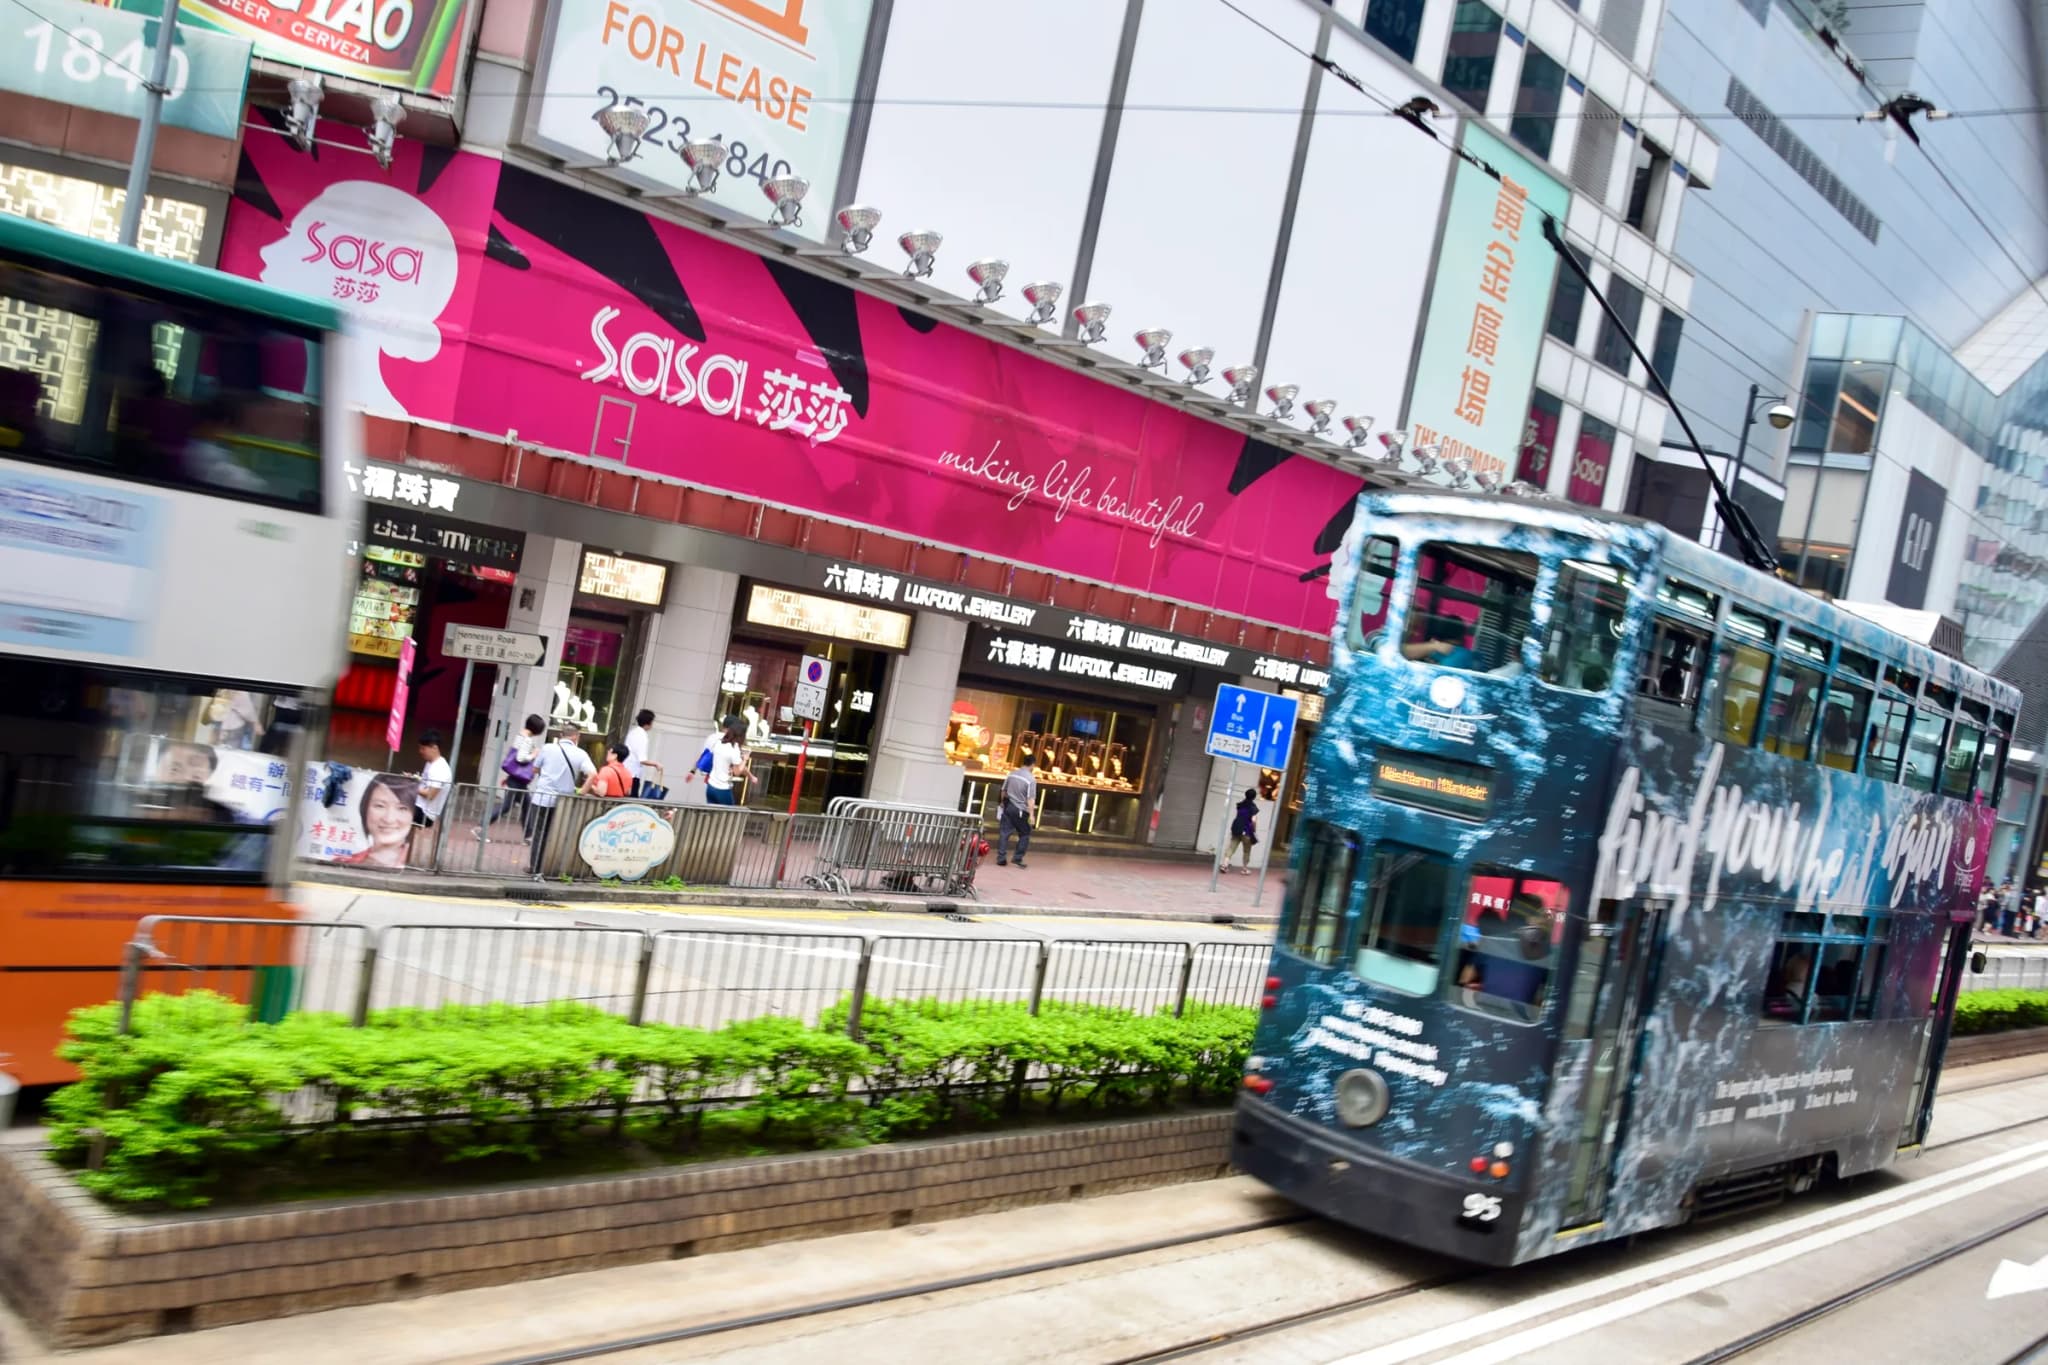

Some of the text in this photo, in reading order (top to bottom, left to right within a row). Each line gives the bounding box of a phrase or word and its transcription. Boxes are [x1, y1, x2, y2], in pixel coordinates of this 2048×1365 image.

[291, 21, 370, 63] CERVEZA
[602, 1, 812, 132] FOR LEASE
[333, 275, 380, 303] 莎莎
[757, 369, 852, 442] 莎莎
[938, 440, 1204, 549] making life beautiful
[1901, 513, 1933, 571] GAP
[824, 564, 1036, 627] 六福珠寶 LUKFOOK JEWELLERY
[458, 631, 517, 645] Hennessy Road
[1066, 616, 1230, 666] 六福珠寶 LUKFOOK JEWELLERY
[987, 637, 1178, 691] 六福珠寶 LUKFOOK JEWELLERY
[812, 706, 821, 717] 12
[1226, 722, 1244, 734] 巴士
[1231, 712, 1244, 722] Bus
[1241, 744, 1251, 753] 12
[1882, 812, 1954, 908] again
[1462, 1192, 1503, 1222] 95
